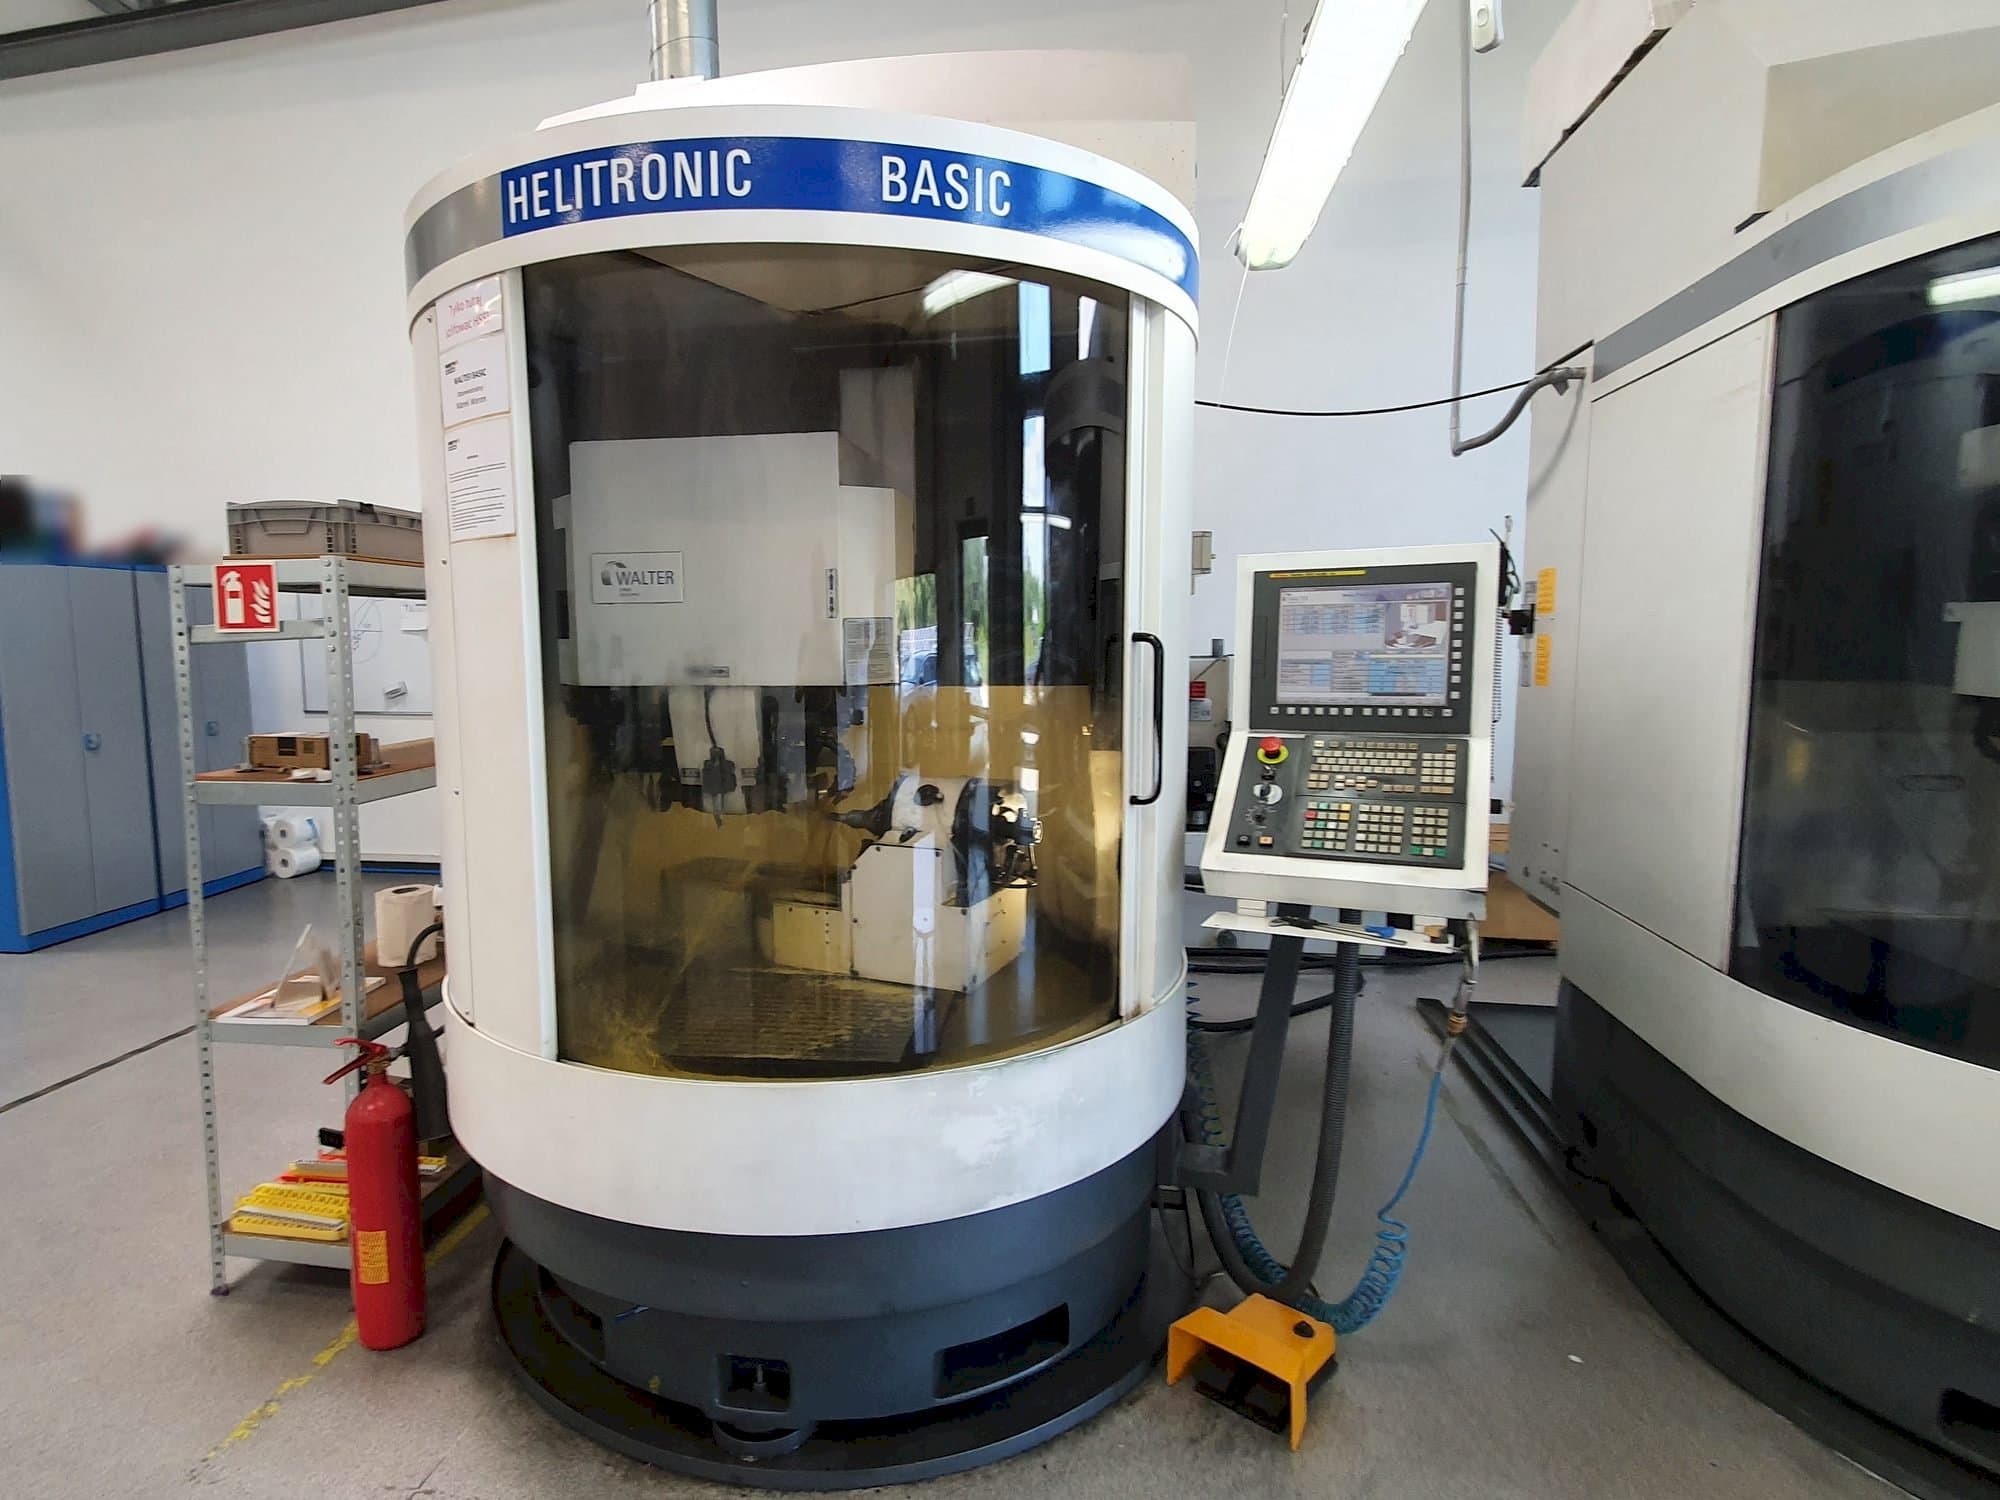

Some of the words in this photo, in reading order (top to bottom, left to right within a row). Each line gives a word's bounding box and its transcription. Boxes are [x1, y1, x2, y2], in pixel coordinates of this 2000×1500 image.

[508, 149, 752, 223] HELITRONIC
[881, 155, 1011, 217] BASIC
[616, 570, 674, 585] WALTER
